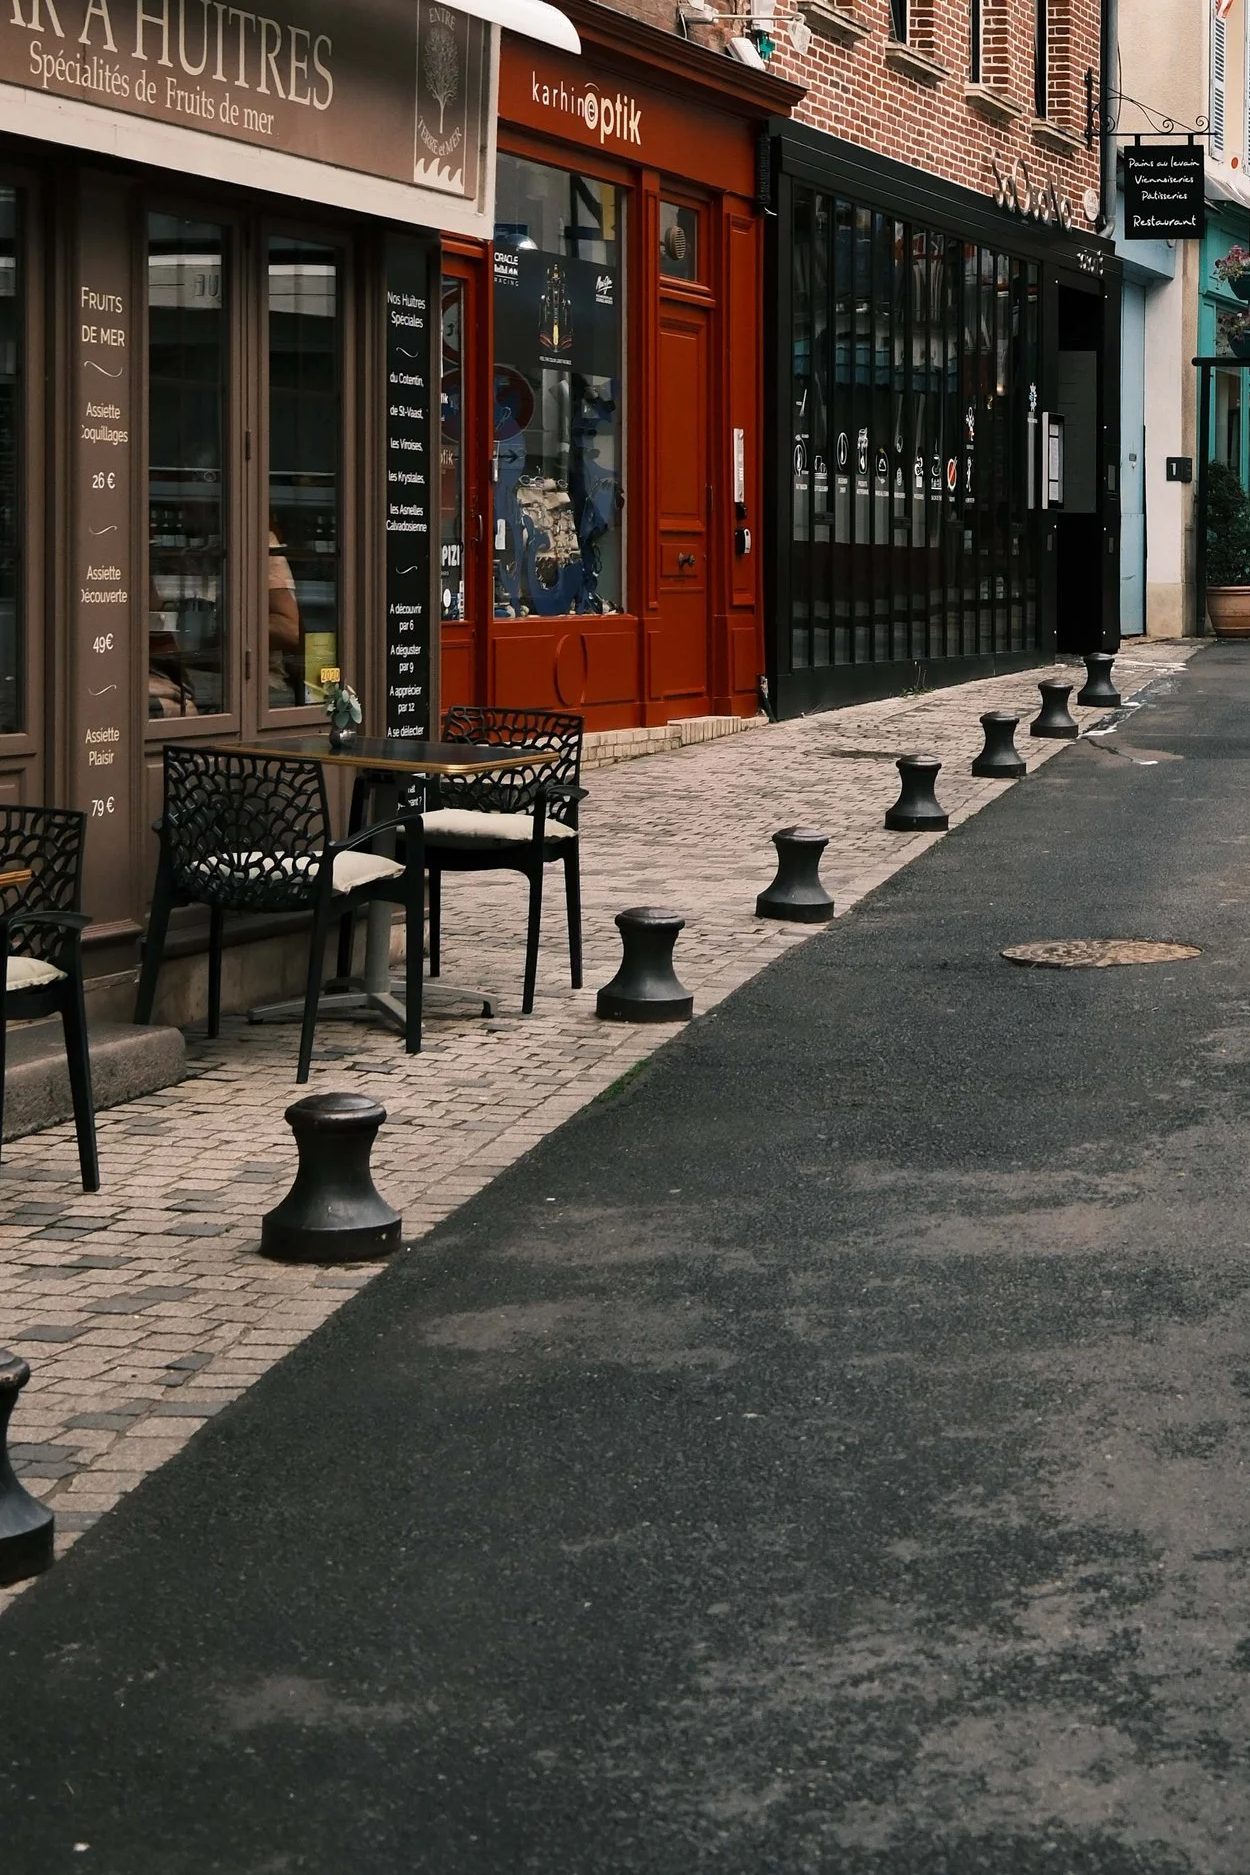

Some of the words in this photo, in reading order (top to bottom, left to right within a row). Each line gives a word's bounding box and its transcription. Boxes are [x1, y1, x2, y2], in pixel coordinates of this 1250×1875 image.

[429, 7, 456, 31] ENTRE
[29, 41, 130, 98] Spécialités
[135, 73, 157, 104] de
[166, 77, 215, 121] Fruits
[219, 94, 239, 126] de
[243, 109, 274, 136] mer
[418, 116, 438, 156] TERRE
[445, 126, 462, 155] MER
[1128, 157, 1154, 169] Pains
[1170, 155, 1200, 168] levain
[1134, 175, 1194, 185] Viennoiseries
[1132, 214, 1197, 228] Restaurant
[495, 252, 519, 265] ORACLE
[81, 287, 123, 313] FRUITS
[387, 291, 401, 305] Nos
[402, 293, 426, 310] Huîtres
[391, 311, 424, 328] Spéciales
[82, 325, 97, 343] DE
[100, 328, 125, 347] MER
[389, 371, 399, 384] du
[86, 402, 121, 419] Assiette
[389, 405, 399, 416] de
[390, 437, 400, 449] les
[388, 470, 398, 482] les
[389, 503, 399, 515] les
[86, 565, 121, 582] Assiette
[399, 620, 409, 633] par
[93, 633, 114, 653] 49€
[396, 643, 421, 658] déguster
[399, 661, 409, 674] par
[395, 684, 422, 699] apprécier
[397, 703, 408, 715] par
[408, 702, 416, 712] 12
[85, 727, 120, 744] Assiette
[89, 750, 114, 766] Plaisir
